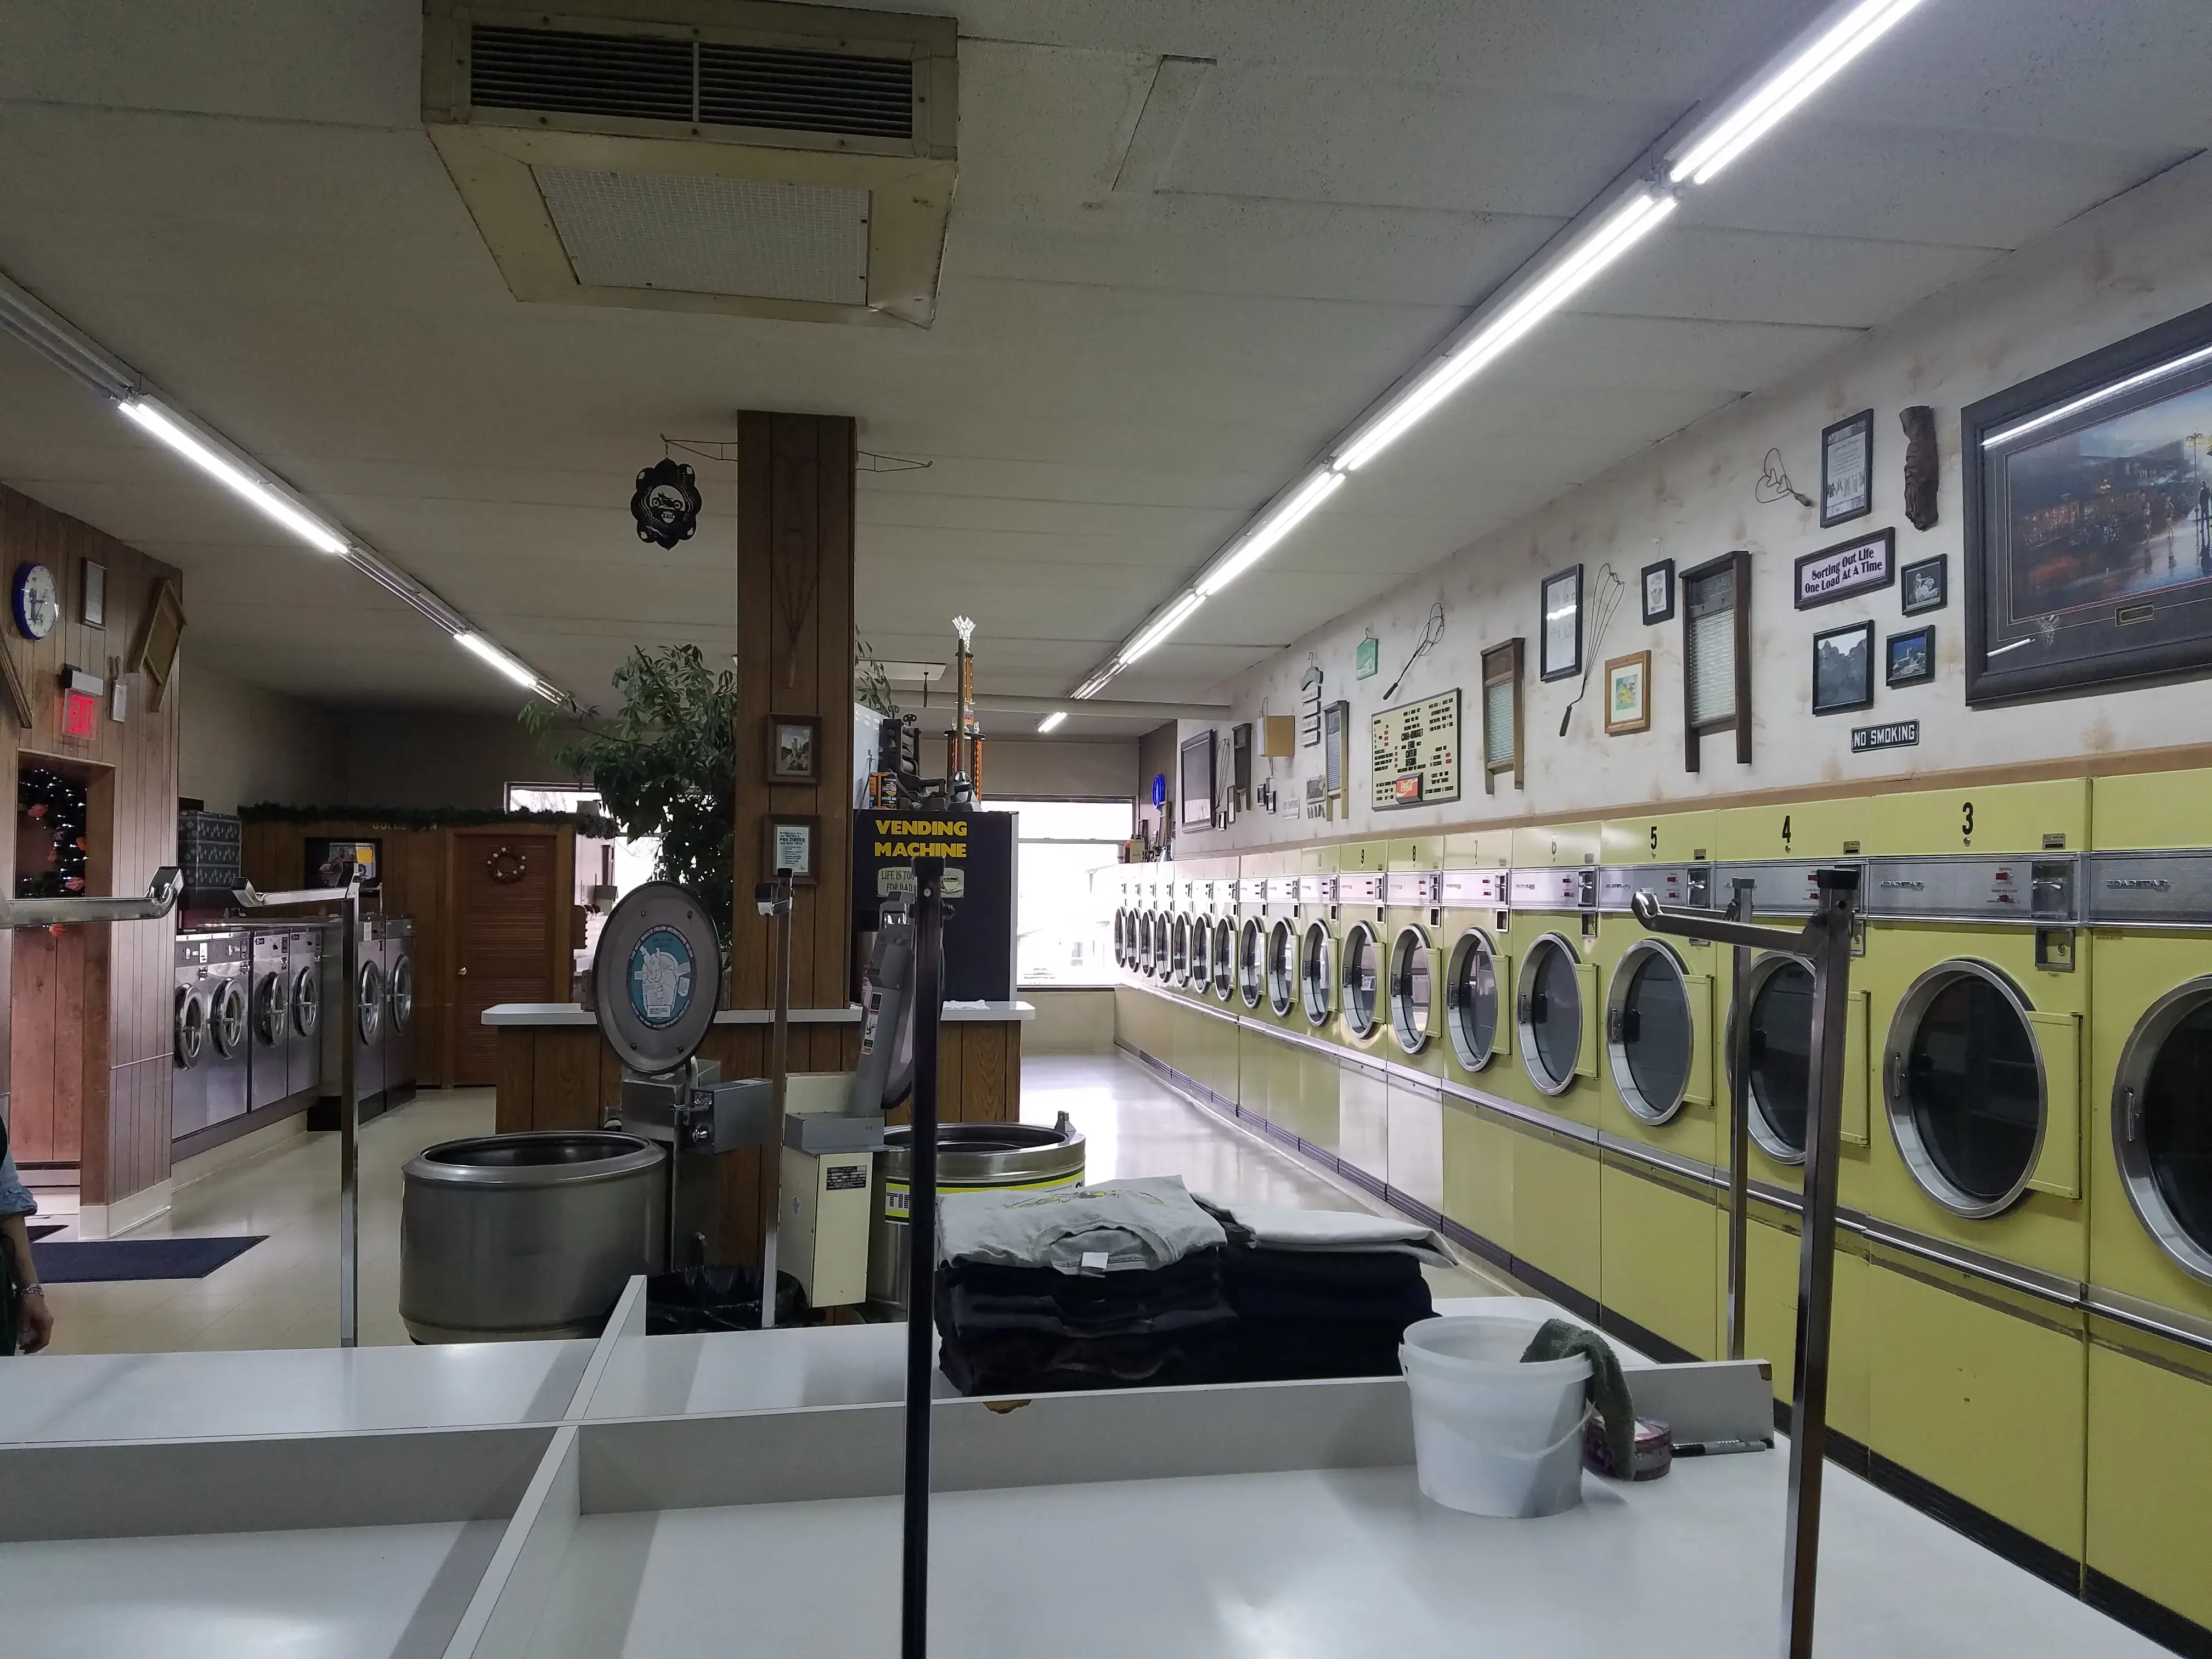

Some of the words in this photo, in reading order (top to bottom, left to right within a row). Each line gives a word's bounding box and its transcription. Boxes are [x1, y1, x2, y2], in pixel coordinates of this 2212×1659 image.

[1812, 560, 1841, 580] Sorting
[1842, 552, 1857, 567] Out
[1859, 548, 1874, 561] Life
[1805, 583, 1820, 594] One
[1821, 573, 1840, 590] Load
[1842, 568, 1852, 582] At
[1853, 565, 1859, 577] A
[1861, 560, 1883, 573] Time
[70, 695, 94, 735] EXIT
[1854, 731, 1866, 747] NO
[1870, 724, 1915, 745] SMOKING
[875, 820, 967, 836] VENDING
[1962, 802, 1973, 835] 3
[1651, 826, 1657, 850] 5
[1782, 815, 1791, 843] 4
[874, 842, 967, 857] MACHINE
[1361, 849, 1364, 864] 9
[1412, 845, 1416, 861] 8
[881, 870, 894, 880] LIFE
[896, 870, 902, 880] IS
[886, 883, 898, 892] FOR
[685, 943, 693, 958] BELOW
